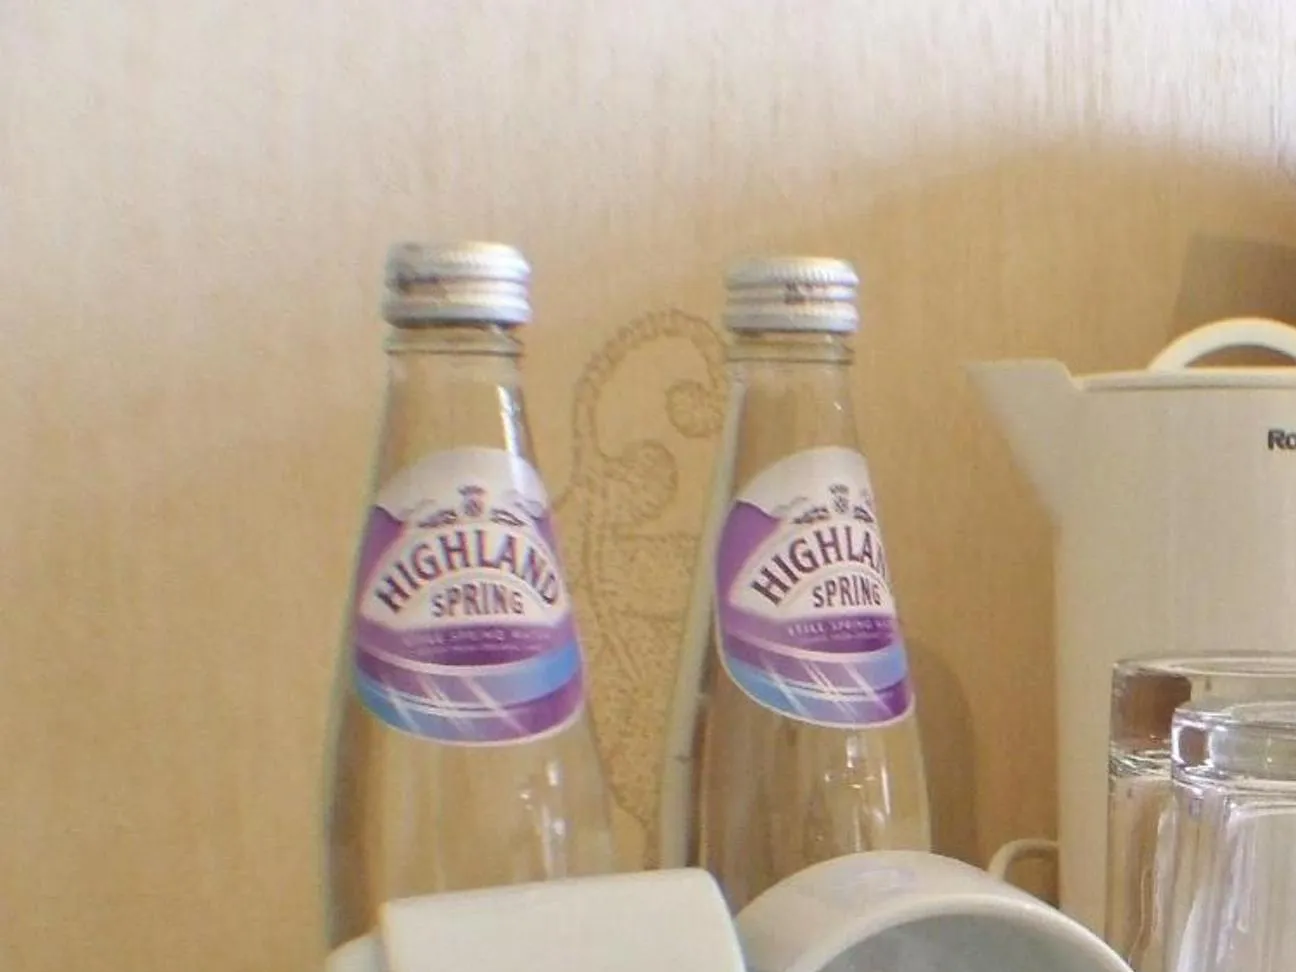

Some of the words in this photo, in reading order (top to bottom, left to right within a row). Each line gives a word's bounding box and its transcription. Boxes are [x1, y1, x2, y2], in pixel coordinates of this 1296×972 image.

[375, 529, 559, 613] HIGHLAND
[431, 581, 525, 617] SPRING
[812, 574, 882, 608] SPRING
